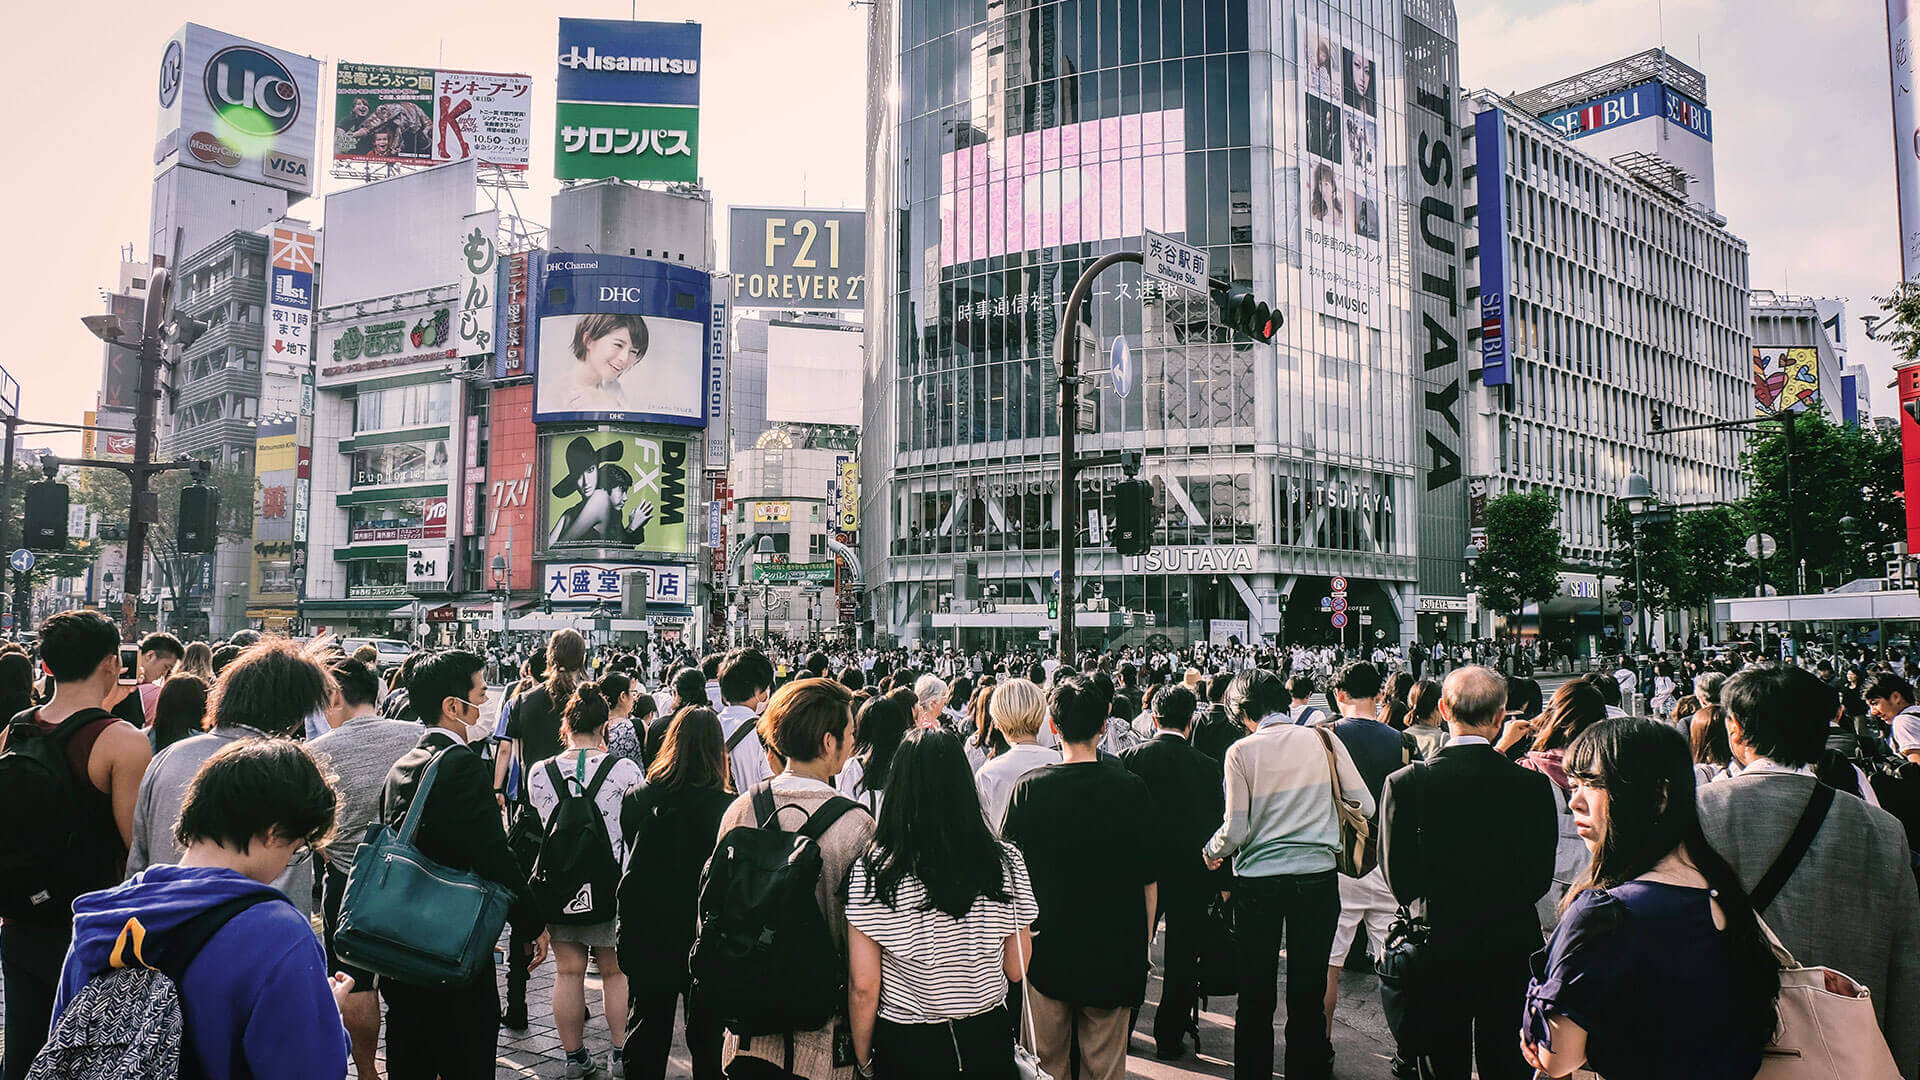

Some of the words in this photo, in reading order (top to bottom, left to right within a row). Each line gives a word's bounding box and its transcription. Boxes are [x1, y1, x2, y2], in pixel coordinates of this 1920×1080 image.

[558, 46, 697, 74] Hisamitsu
[337, 70, 433, 90] 恐竜どうぶつ園
[440, 79, 528, 98] キンキーブーツ
[1551, 92, 1641, 138] SEIBU
[1665, 92, 1709, 137] SEIBU
[561, 125, 691, 156] サロンパス
[270, 158, 307, 177] VISA
[272, 232, 314, 270] 本
[765, 218, 840, 269] F21
[1150, 238, 1204, 275] 渋谷駅前
[546, 263, 564, 272] DHC
[564, 261, 598, 271] Channel
[1158, 263, 1184, 281] Shibuya
[460, 226, 495, 350] もんじゃ
[600, 286, 641, 303] DHC
[734, 274, 840, 300] FOREVER
[1416, 83, 1461, 492] TSUTAYA
[958, 280, 1179, 322] 時事通信社ニース速報
[1336, 294, 1368, 315] MUSIC
[272, 309, 309, 326] 夜11時
[712, 300, 726, 361] Taisei
[1483, 292, 1502, 369] SEIBU
[279, 325, 301, 337] まで
[286, 342, 308, 356] 地下
[711, 366, 723, 418] neon
[609, 412, 625, 421] DHC
[358, 469, 421, 486] Euphoria
[633, 437, 660, 495] FX
[660, 440, 686, 526] DMM
[958, 479, 1057, 500] STARBUCK
[426, 502, 447, 521] JTB
[489, 463, 534, 535] クスリ
[1315, 486, 1393, 514] TSUTAYA
[550, 570, 680, 596] 大盛堂店
[1570, 581, 1599, 598] SEIBU
[1421, 599, 1448, 609] TSUTAYA
